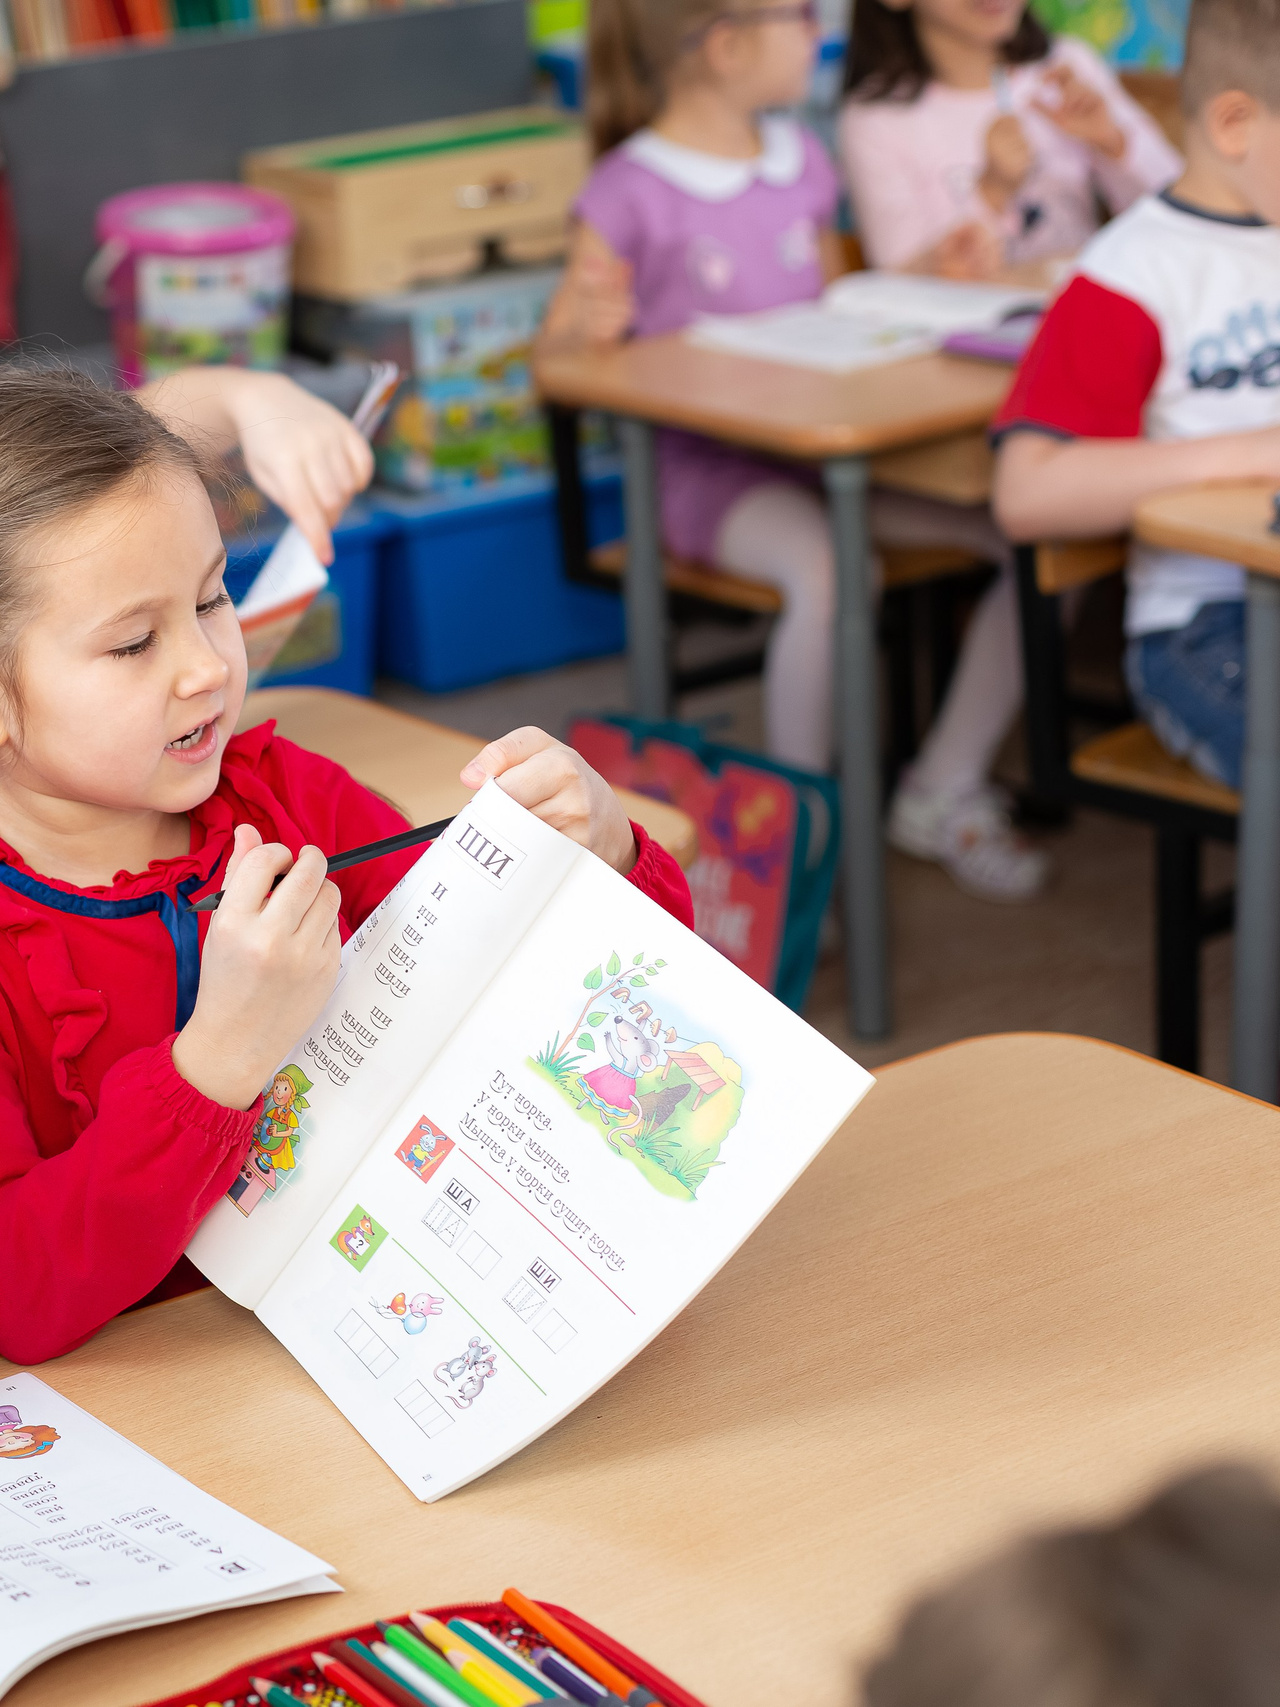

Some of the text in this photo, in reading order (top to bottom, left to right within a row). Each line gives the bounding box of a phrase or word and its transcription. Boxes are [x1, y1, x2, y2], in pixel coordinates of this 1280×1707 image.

[455, 822, 515, 879] ШИ
[430, 881, 448, 902] И
[417, 904, 439, 926] иш
[403, 923, 425, 946] ши
[389, 943, 418, 971] шил
[375, 962, 412, 997] шили
[340, 1009, 379, 1047] мыши
[369, 1005, 393, 1028] ши
[305, 1036, 351, 1085] малыши
[323, 1023, 365, 1066] крыши
[491, 1069, 553, 1131] Тут норка.
[487, 1104, 527, 1142] норки
[524, 1137, 571, 1183] мышка.
[446, 1181, 473, 1211] ША
[459, 1111, 507, 1160] Мышка
[516, 1164, 555, 1202] норки
[552, 1198, 591, 1235] сушит
[589, 1232, 626, 1271] корки.
[529, 1260, 557, 1289] ШИ
[0, 1474, 43, 1493] трава
